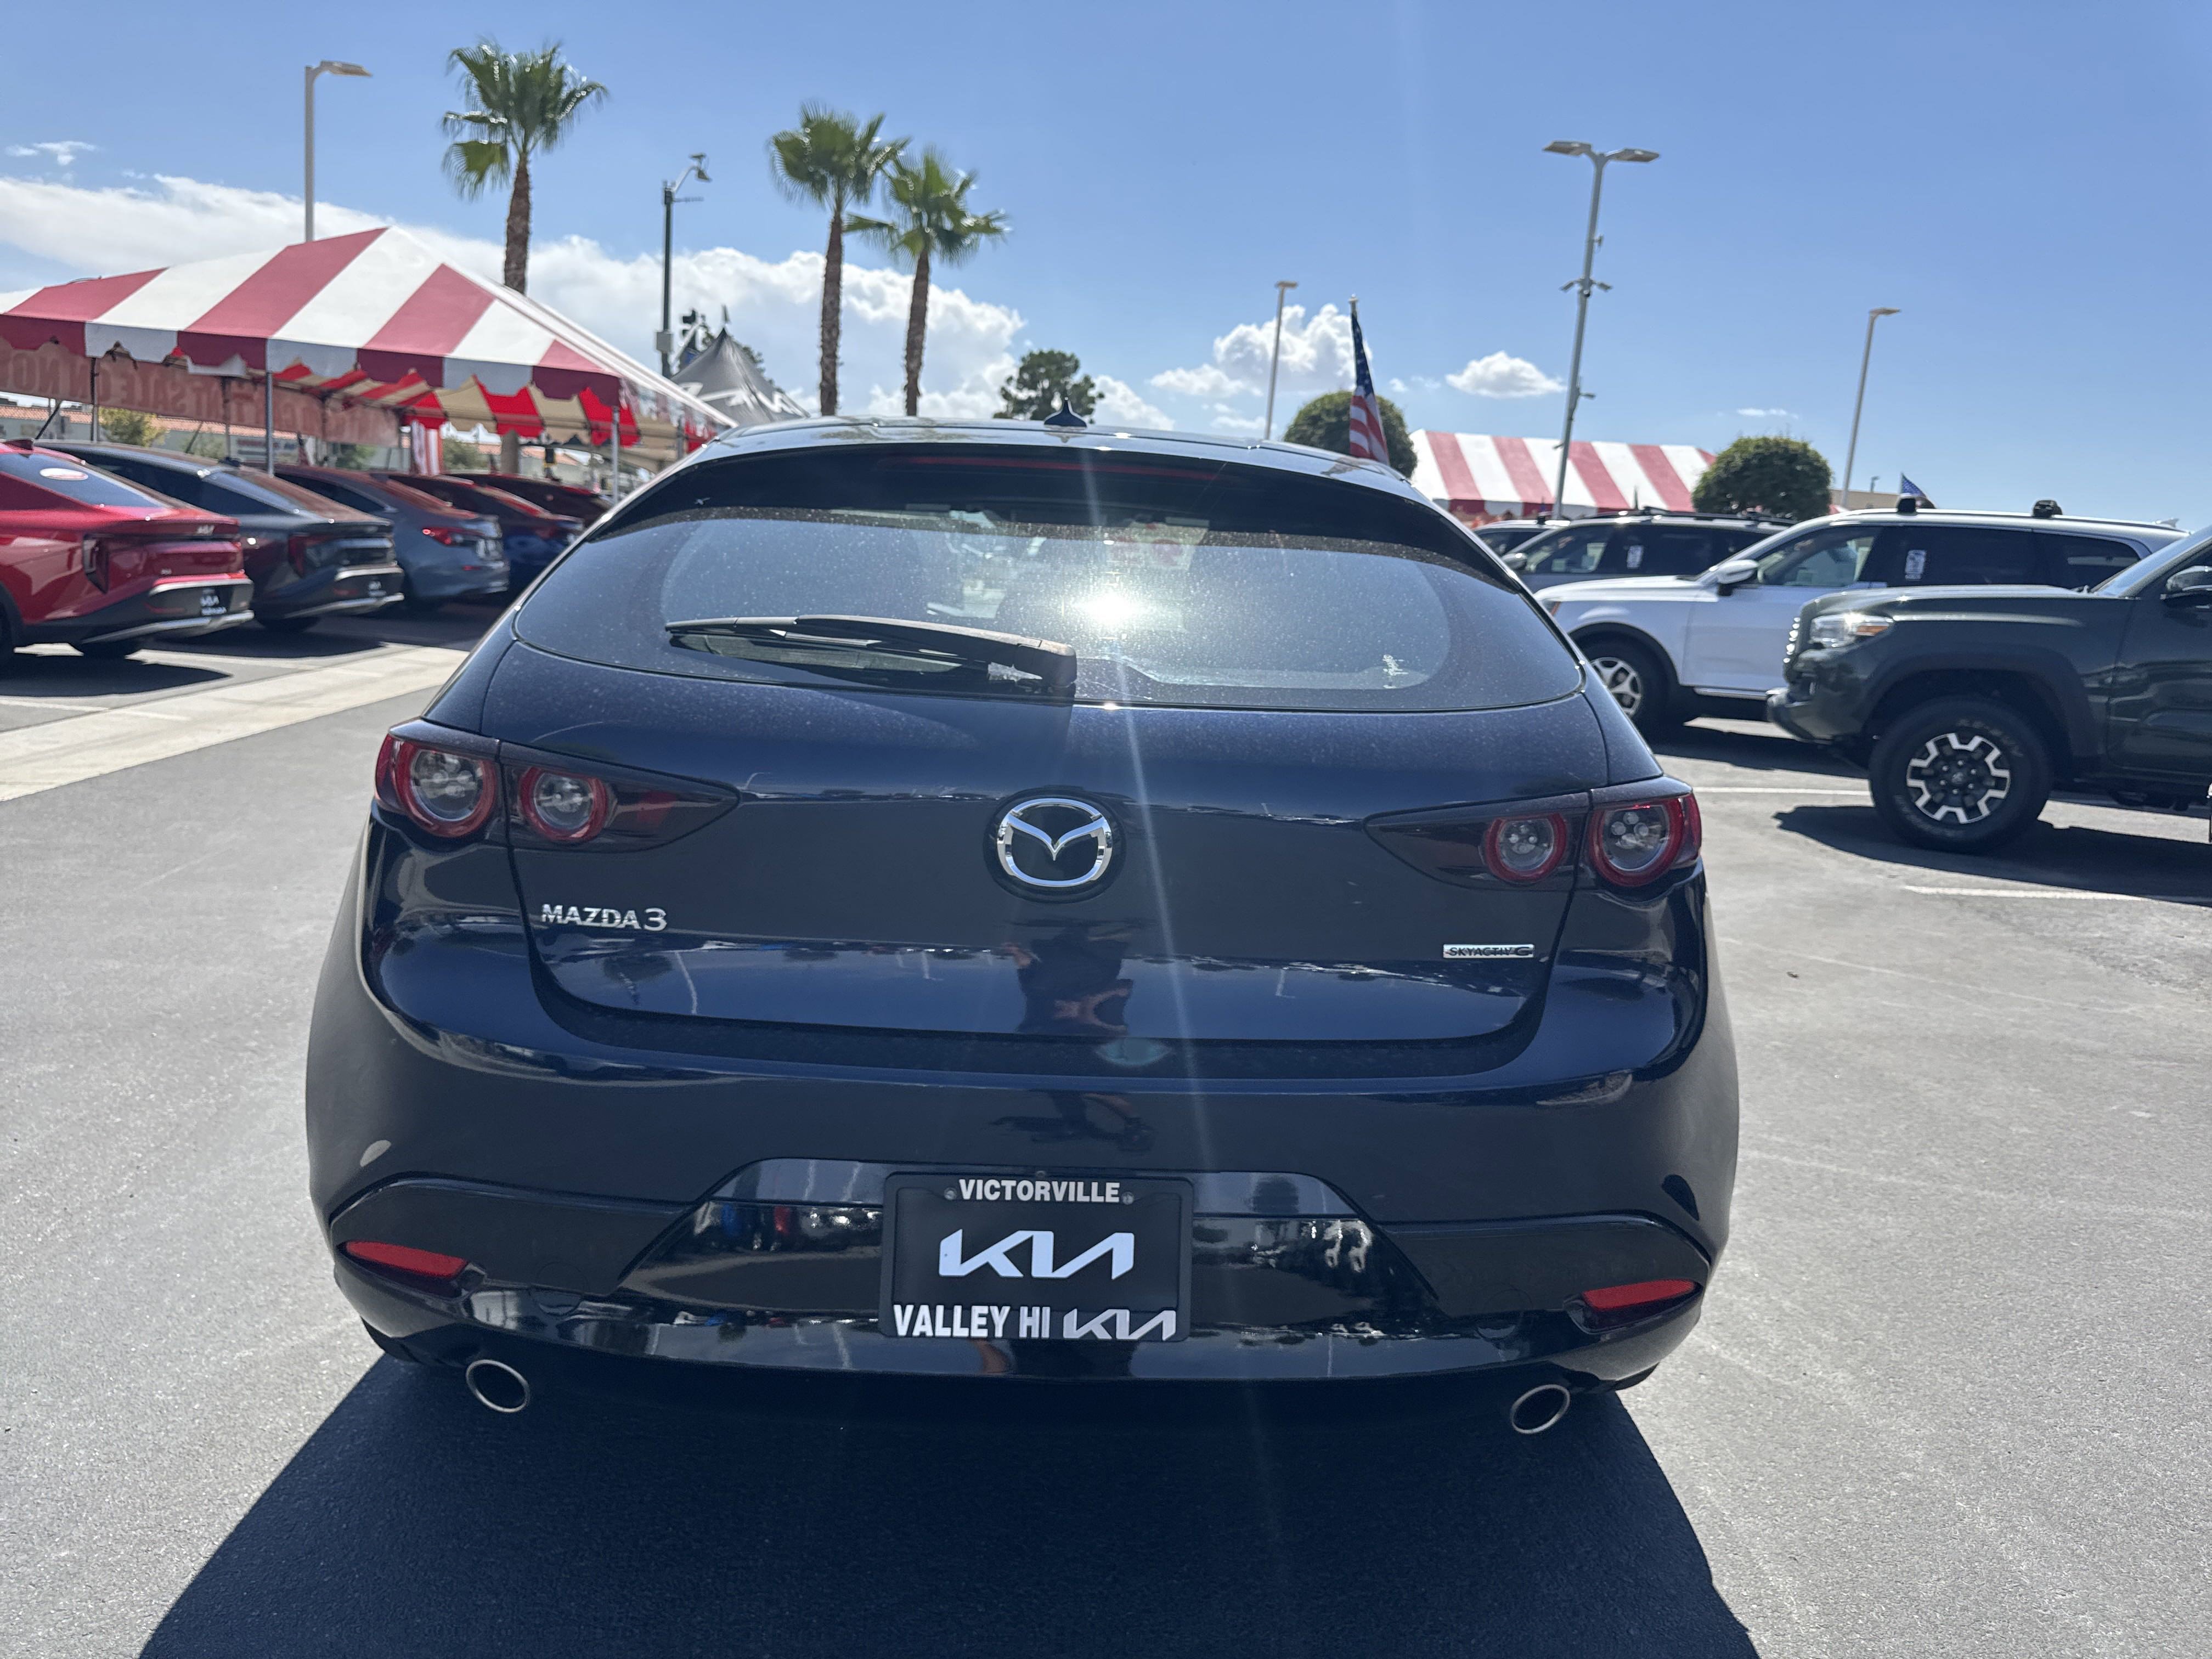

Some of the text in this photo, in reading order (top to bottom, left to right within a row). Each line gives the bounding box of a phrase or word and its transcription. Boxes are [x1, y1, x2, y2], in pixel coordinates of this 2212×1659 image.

[958, 1178, 1120, 1203] VICTORVILLE
[939, 1229, 1135, 1280] KIA
[894, 1304, 1177, 1341] VALLEY HI KIA
